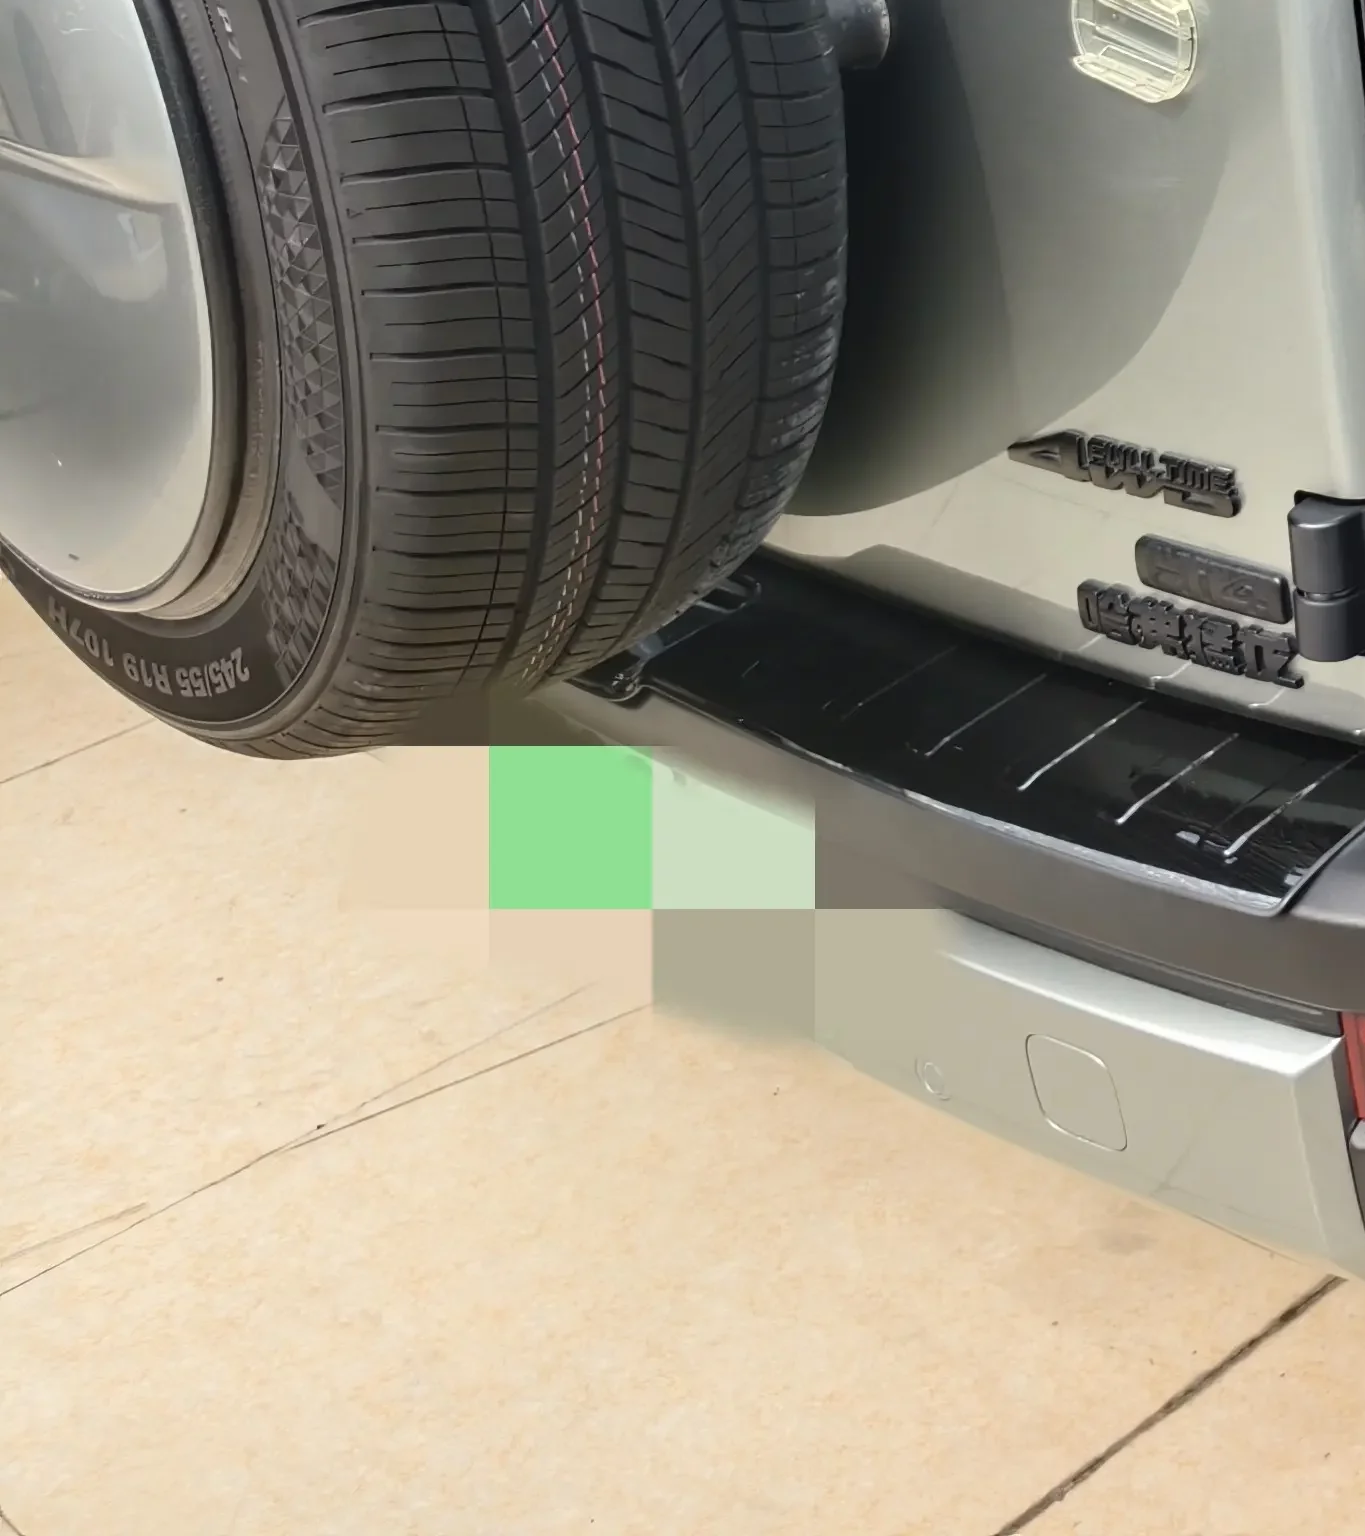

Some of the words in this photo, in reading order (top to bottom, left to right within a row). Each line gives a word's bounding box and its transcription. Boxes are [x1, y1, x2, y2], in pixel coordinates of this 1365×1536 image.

[47, 595, 114, 667] 107H
[122, 652, 173, 696] R19
[175, 647, 250, 697] 245/55
